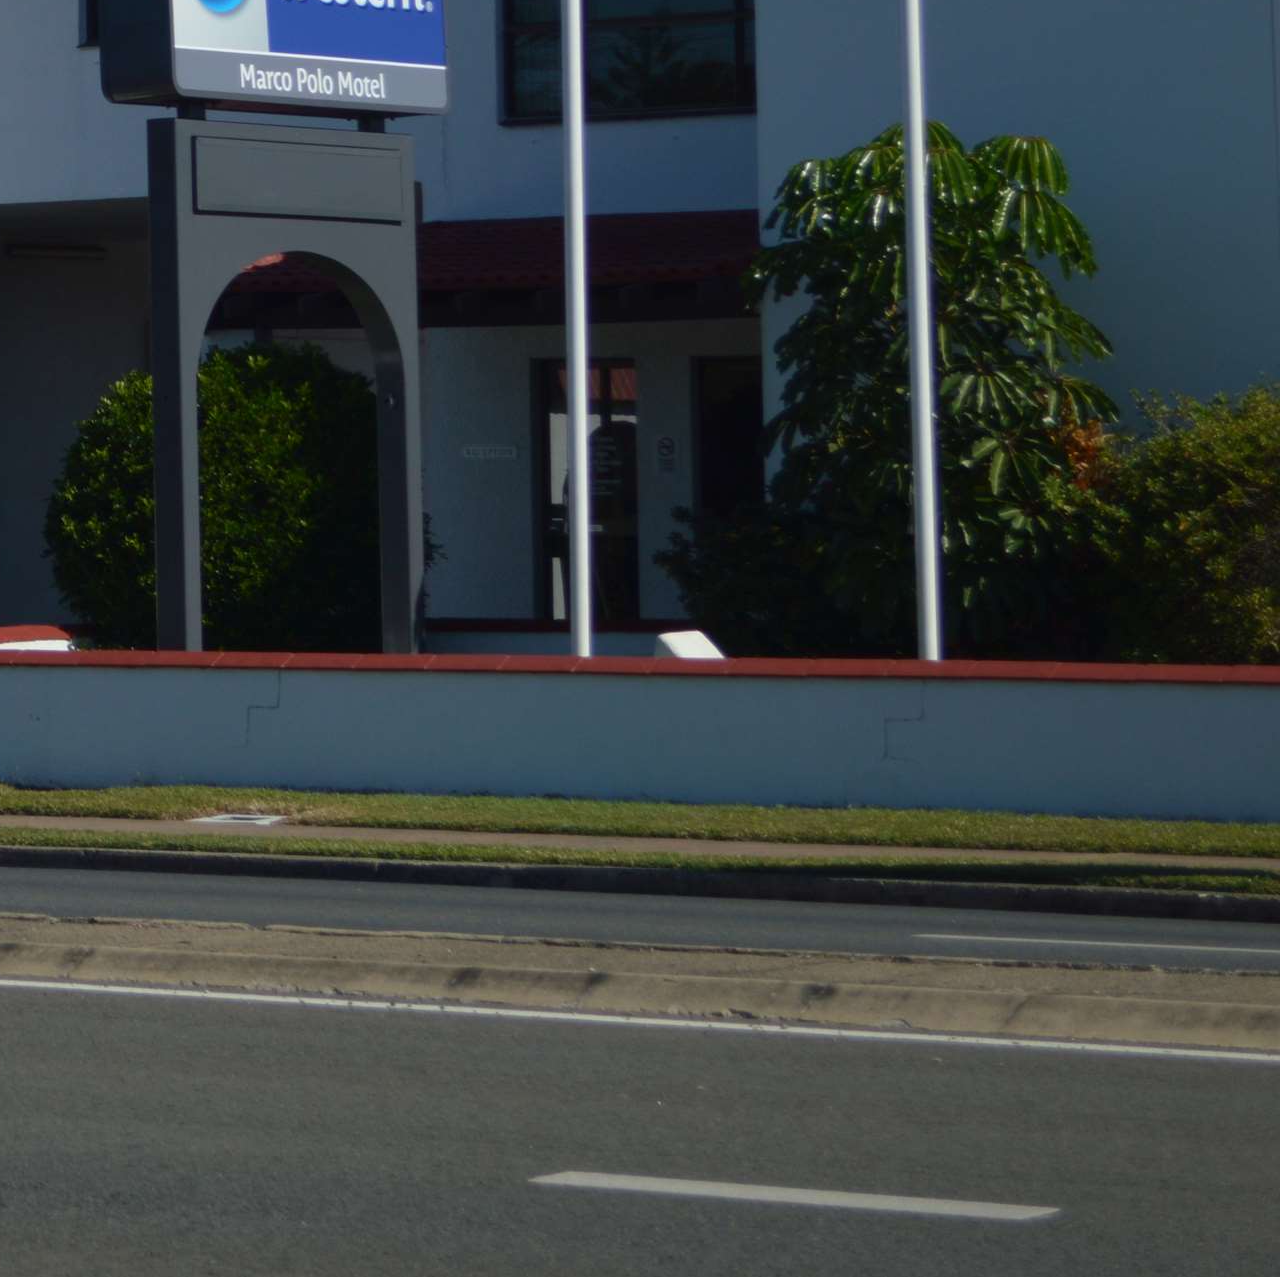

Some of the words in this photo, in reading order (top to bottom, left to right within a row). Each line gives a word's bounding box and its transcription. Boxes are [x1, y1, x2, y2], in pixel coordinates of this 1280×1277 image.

[239, 63, 292, 92] Marco
[296, 67, 334, 95] Polo
[338, 70, 386, 99] Motel
